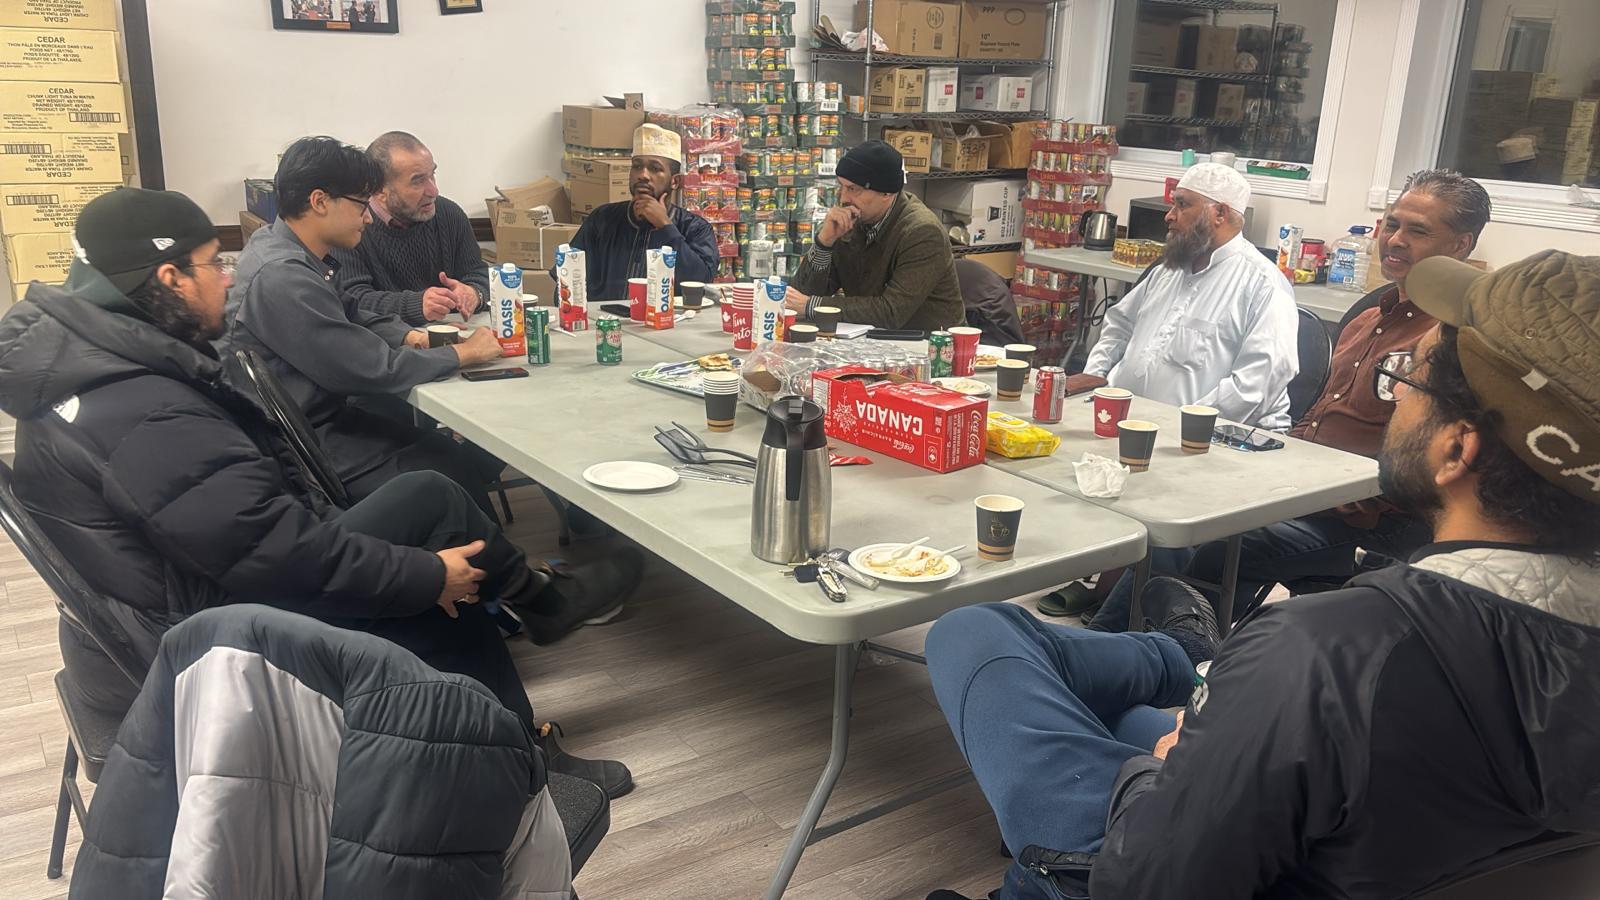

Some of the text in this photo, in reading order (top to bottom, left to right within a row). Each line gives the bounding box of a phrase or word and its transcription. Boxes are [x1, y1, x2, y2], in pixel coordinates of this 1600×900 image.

[661, 277, 670, 312] OASIS
[501, 299, 512, 339] OASIS
[732, 312, 746, 328] Tim
[763, 312, 775, 340] ASIS
[856, 400, 923, 436] CANADA
[969, 409, 982, 459] Coca-Cola
